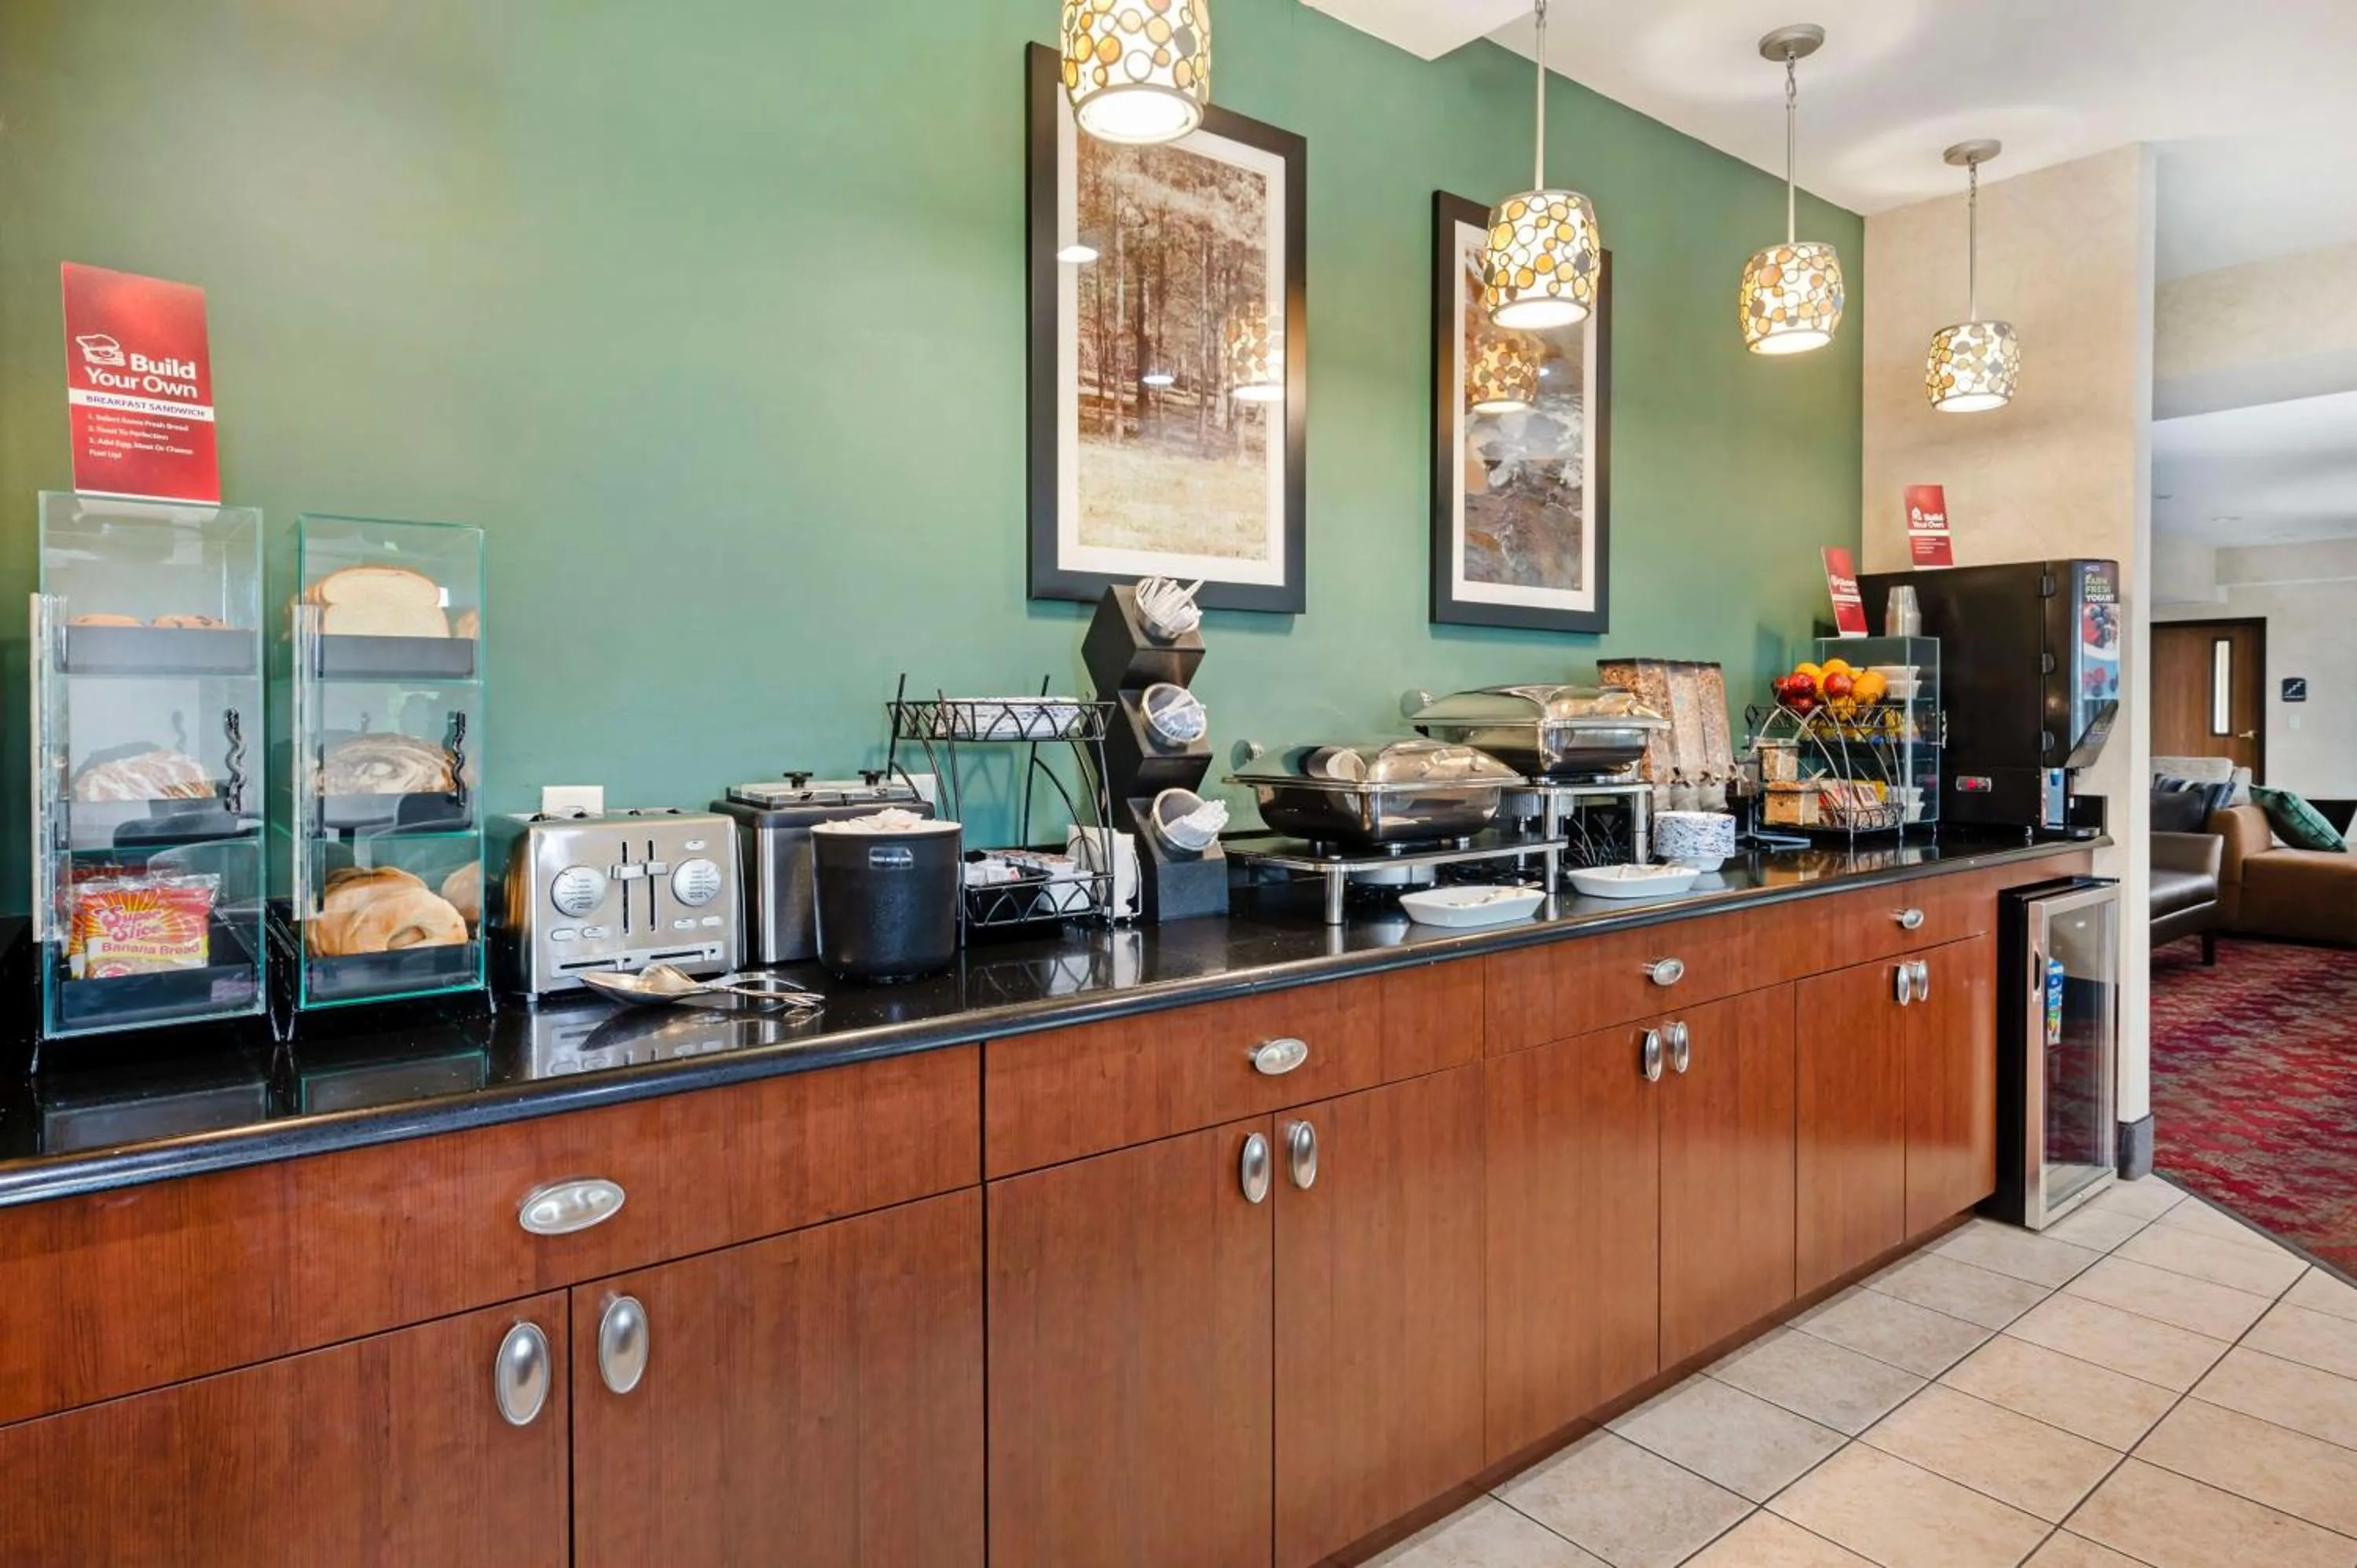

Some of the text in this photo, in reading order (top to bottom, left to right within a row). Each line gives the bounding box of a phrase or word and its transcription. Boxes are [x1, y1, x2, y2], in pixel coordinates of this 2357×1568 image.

[130, 353, 196, 380] Build
[84, 365, 198, 399] Your Own
[86, 394, 205, 417] BREAKFAST SANDWICH
[93, 905, 162, 929] Super
[110, 921, 162, 942] Slice
[101, 942, 200, 955] Banana Bread
